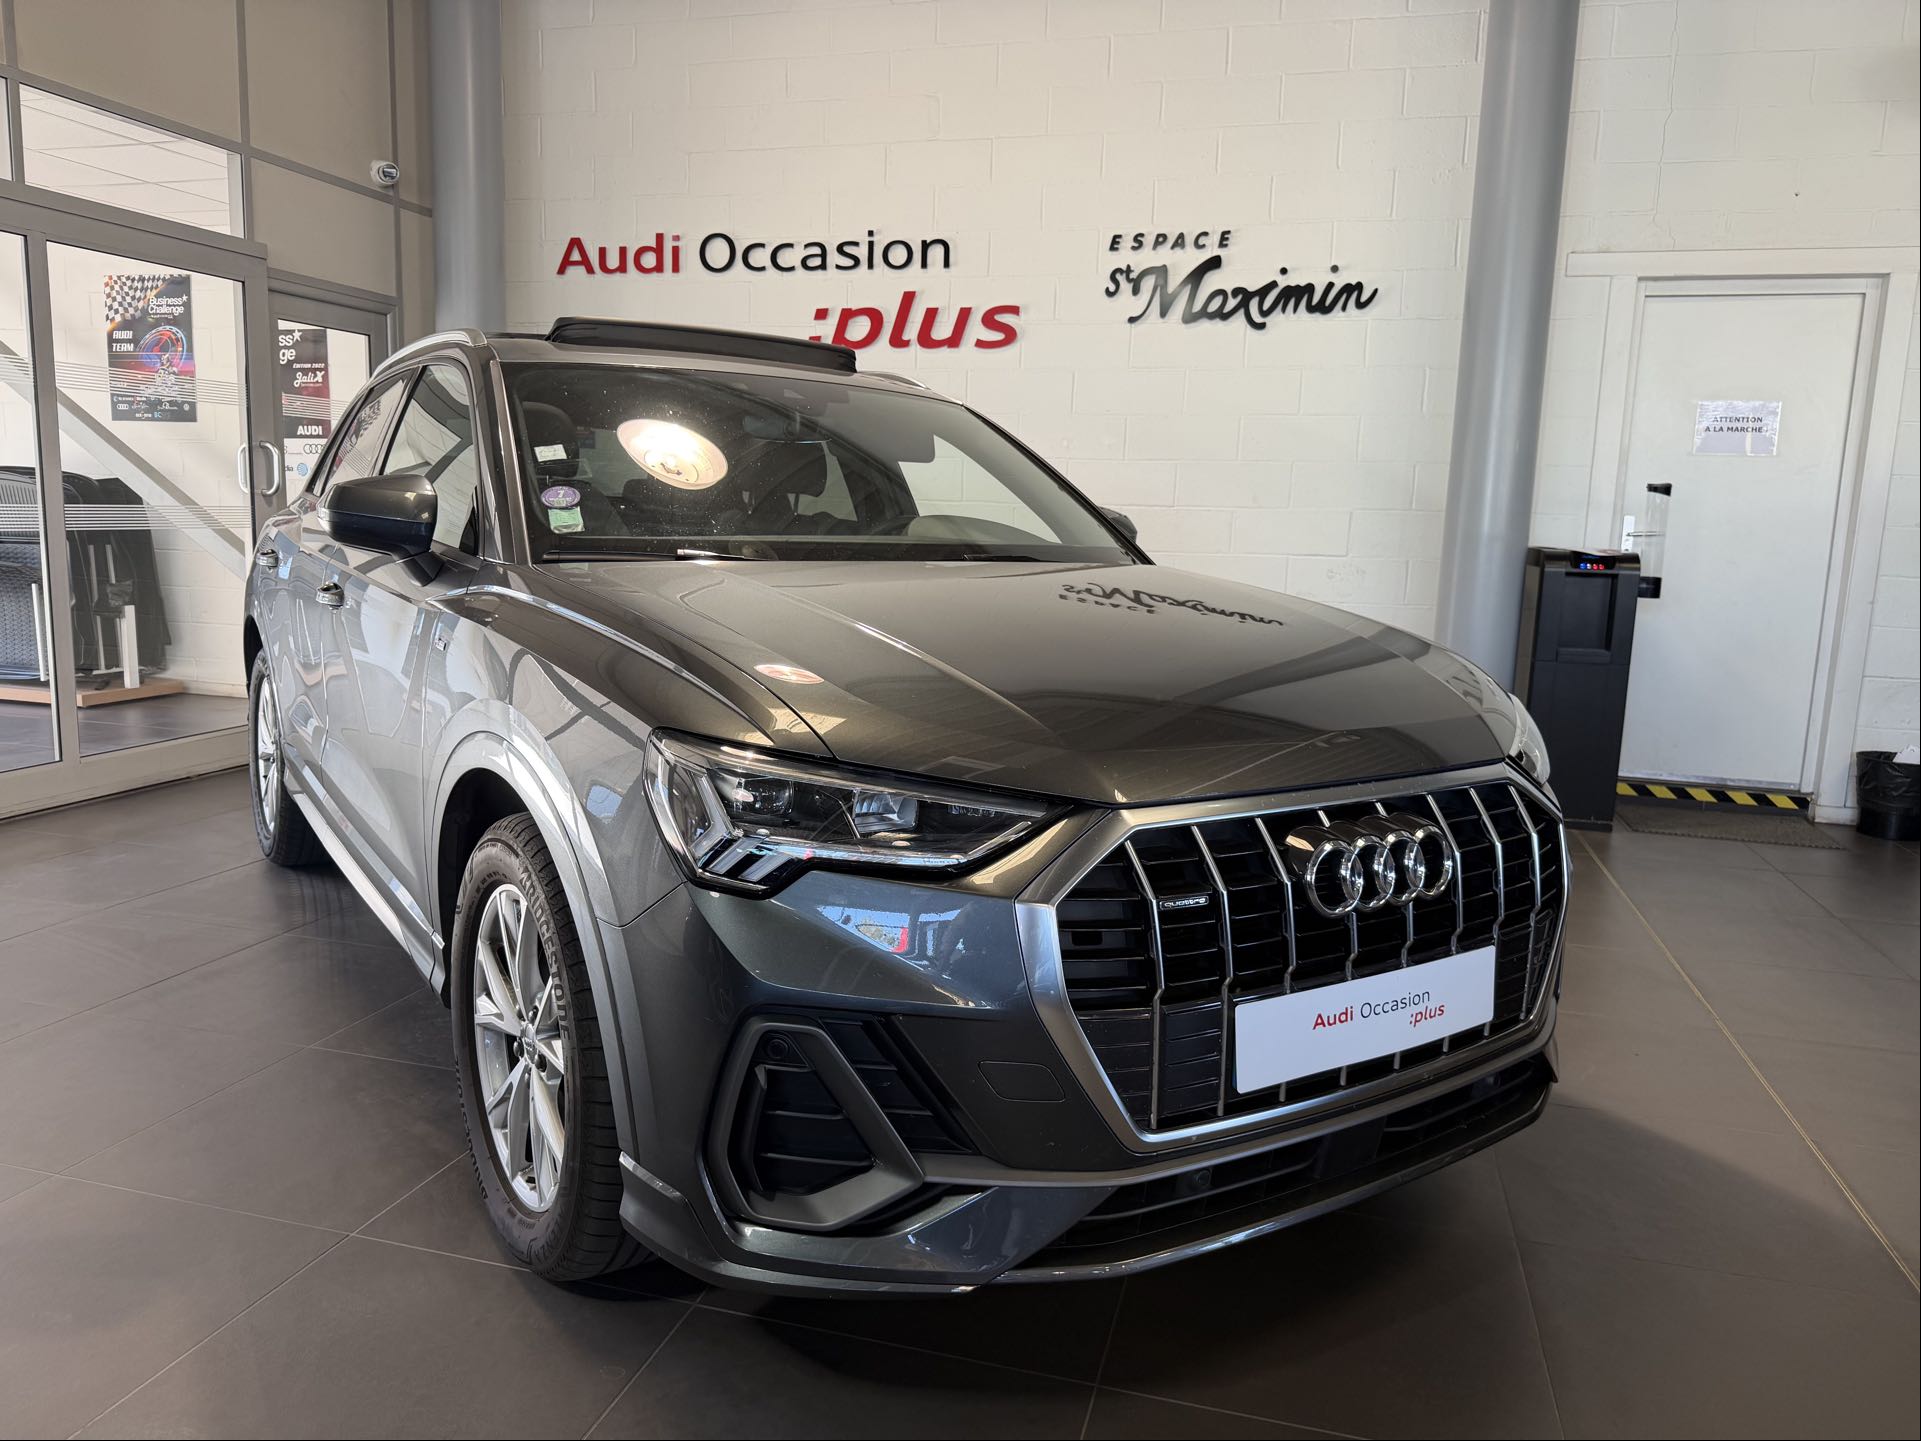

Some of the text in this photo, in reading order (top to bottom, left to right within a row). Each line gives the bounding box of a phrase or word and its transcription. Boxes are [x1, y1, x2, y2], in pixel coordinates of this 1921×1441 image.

[1109, 230, 1231, 251] ESPACE
[556, 230, 951, 275] Audi Occasion
[149, 295, 183, 305] Business
[1105, 255, 1378, 330] St Maximin
[148, 304, 184, 316] Challenge
[808, 291, 1020, 350] :plus
[113, 330, 133, 339] AUDI
[112, 343, 134, 352] TEAM
[296, 425, 323, 436] AUDI
[1164, 898, 1206, 908] quattro
[1312, 989, 1430, 1030] Audi Occasion
[1409, 1003, 1445, 1028] :plus
